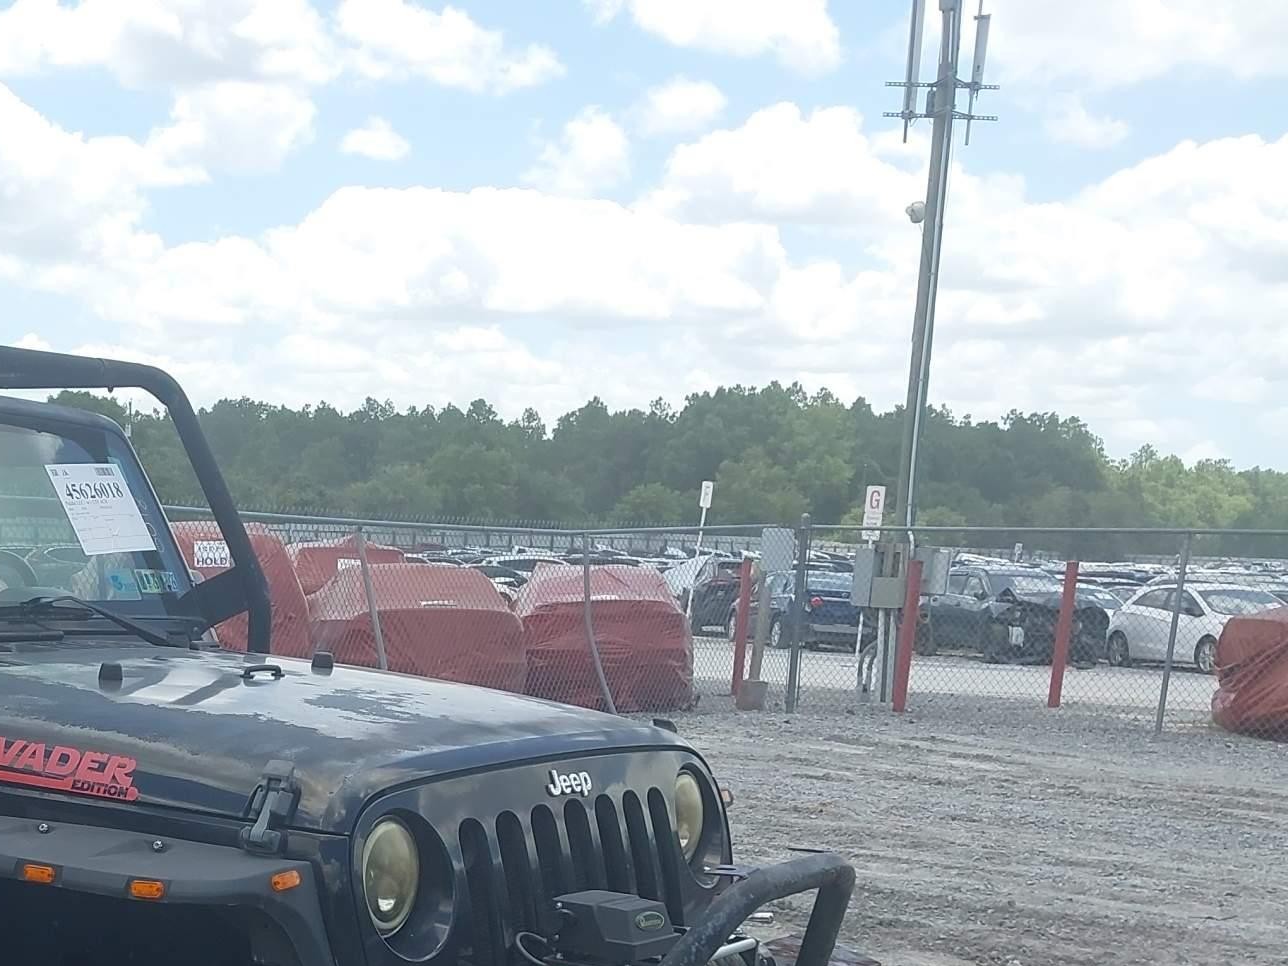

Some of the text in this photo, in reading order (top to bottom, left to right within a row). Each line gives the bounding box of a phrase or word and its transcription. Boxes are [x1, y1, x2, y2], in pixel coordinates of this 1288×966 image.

[65, 482, 124, 500] 45626018
[870, 490, 881, 510] G
[196, 557, 228, 566] HOLD
[71, 779, 129, 799] EDITION
[547, 769, 593, 797] Jeep
